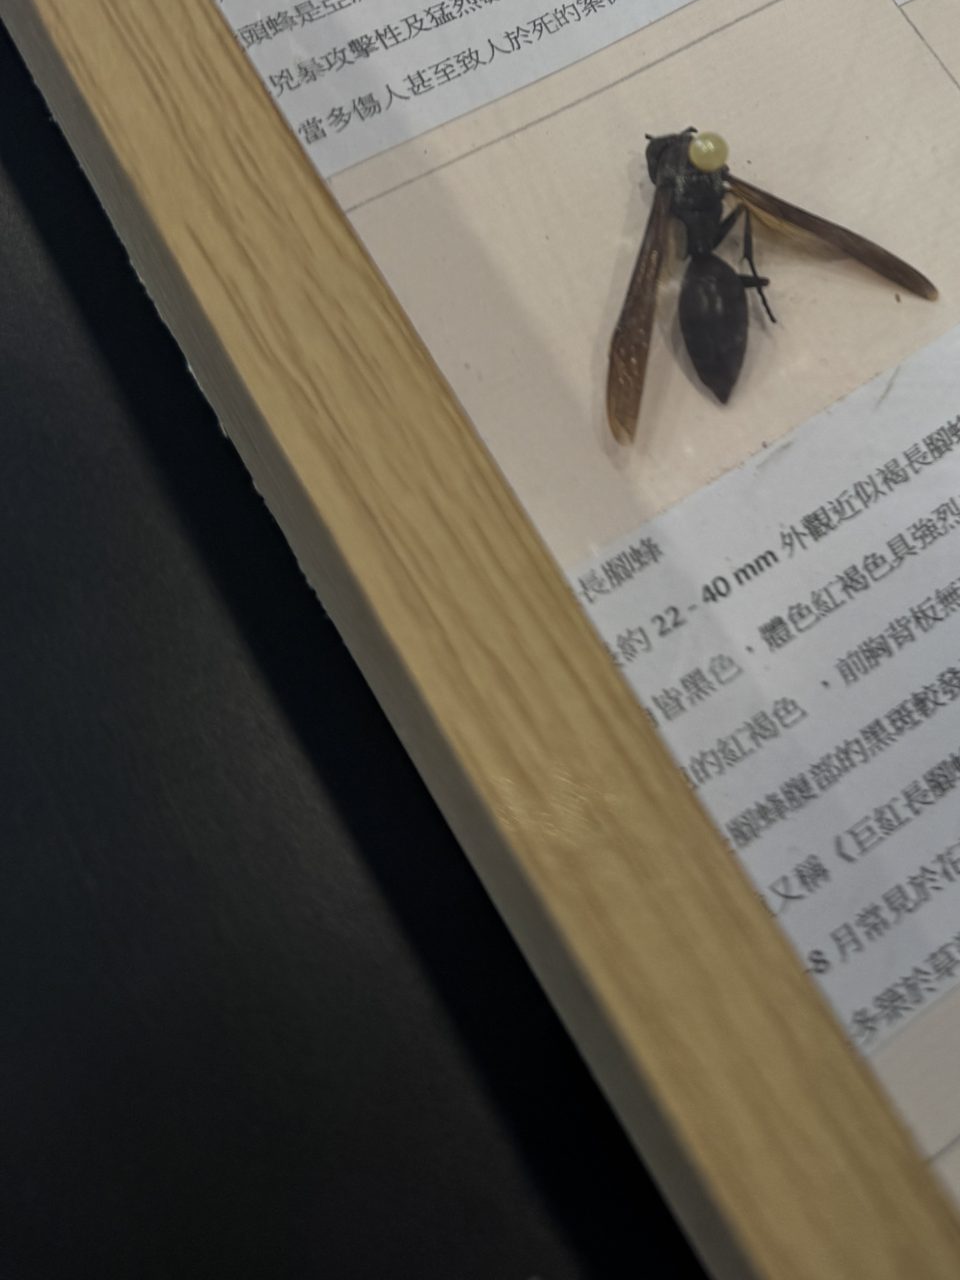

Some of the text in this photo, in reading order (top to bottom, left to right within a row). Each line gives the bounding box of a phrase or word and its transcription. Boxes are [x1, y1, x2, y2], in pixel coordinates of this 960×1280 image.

[650, 605, 687, 638] 22
[702, 575, 732, 603] 40
[732, 549, 780, 586] mm
[669, 696, 809, 800] 的紅褐色
